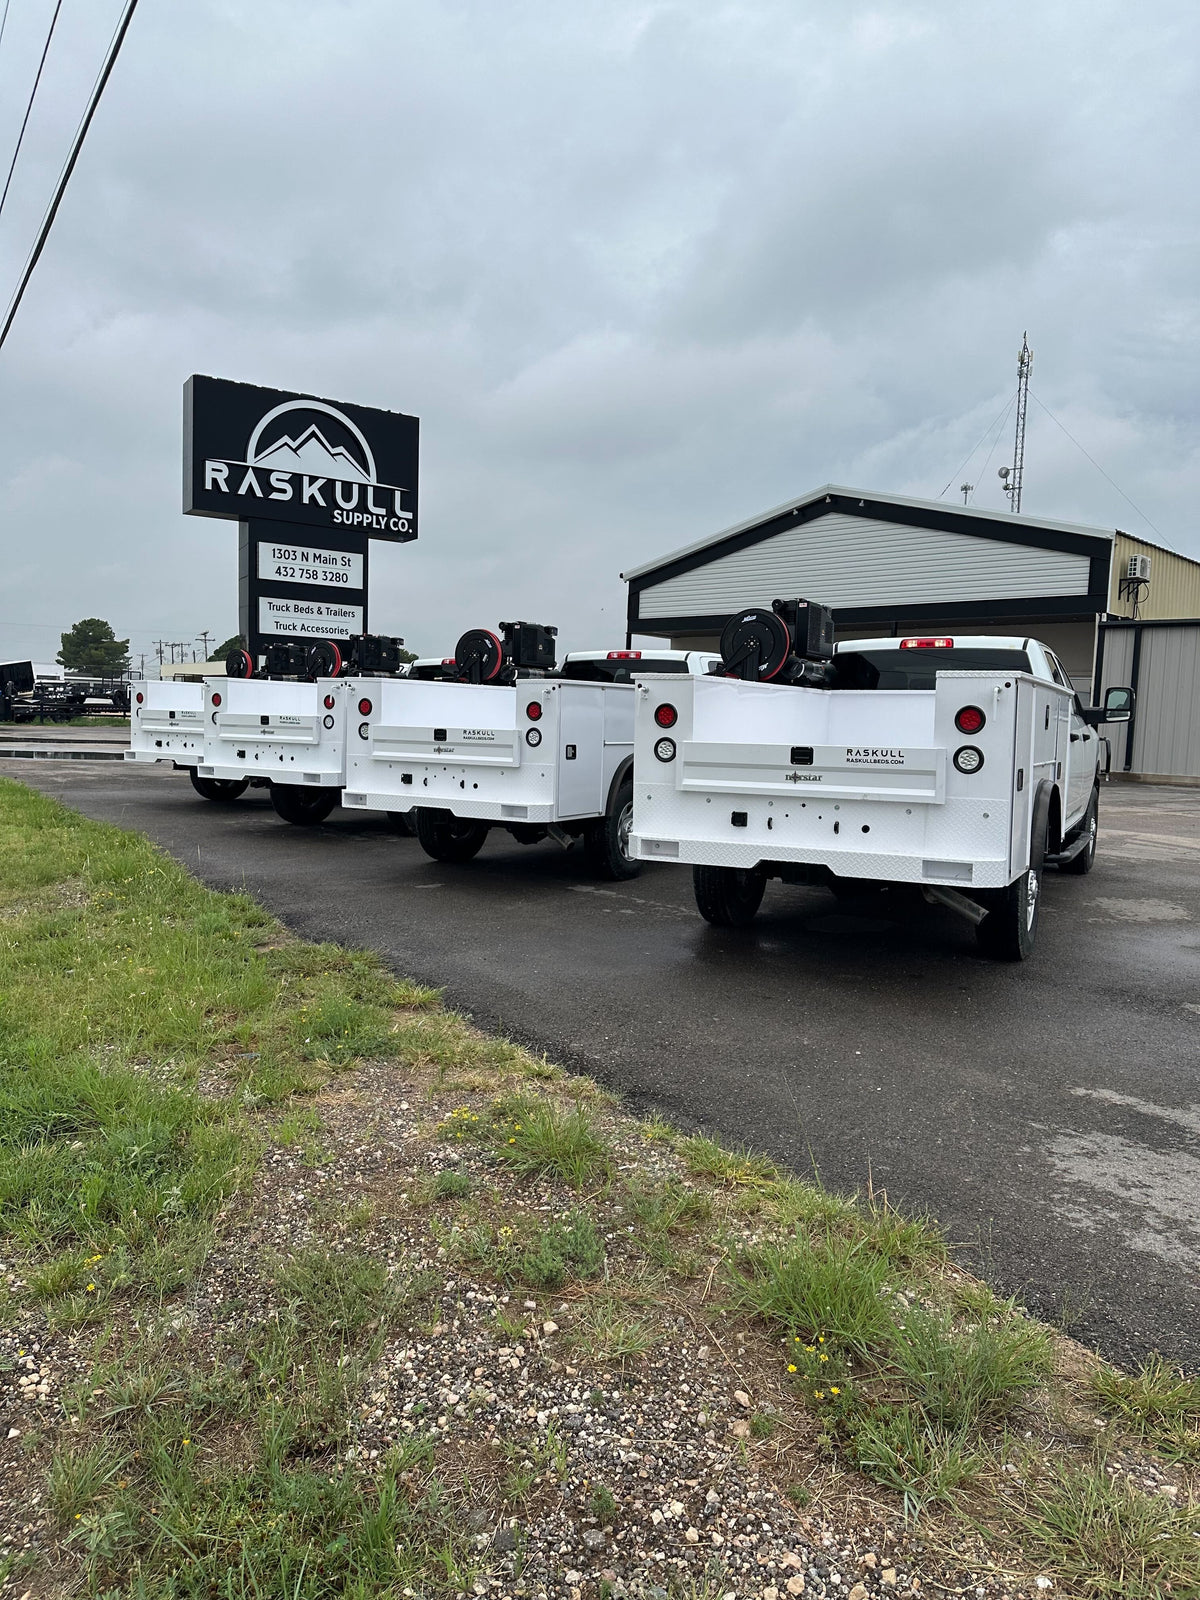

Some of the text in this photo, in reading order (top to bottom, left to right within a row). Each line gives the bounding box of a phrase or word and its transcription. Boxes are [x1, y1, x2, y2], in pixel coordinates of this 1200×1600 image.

[204, 460, 413, 519] RASKULL
[333, 509, 413, 533] SUPPLY CO.
[272, 548, 352, 567] 1303 N Main St
[275, 566, 349, 583] 432 758 3280
[267, 601, 356, 618] Truck Beds & Trailers
[274, 621, 349, 635] Truck Accessories
[846, 748, 905, 758] RASKULL
